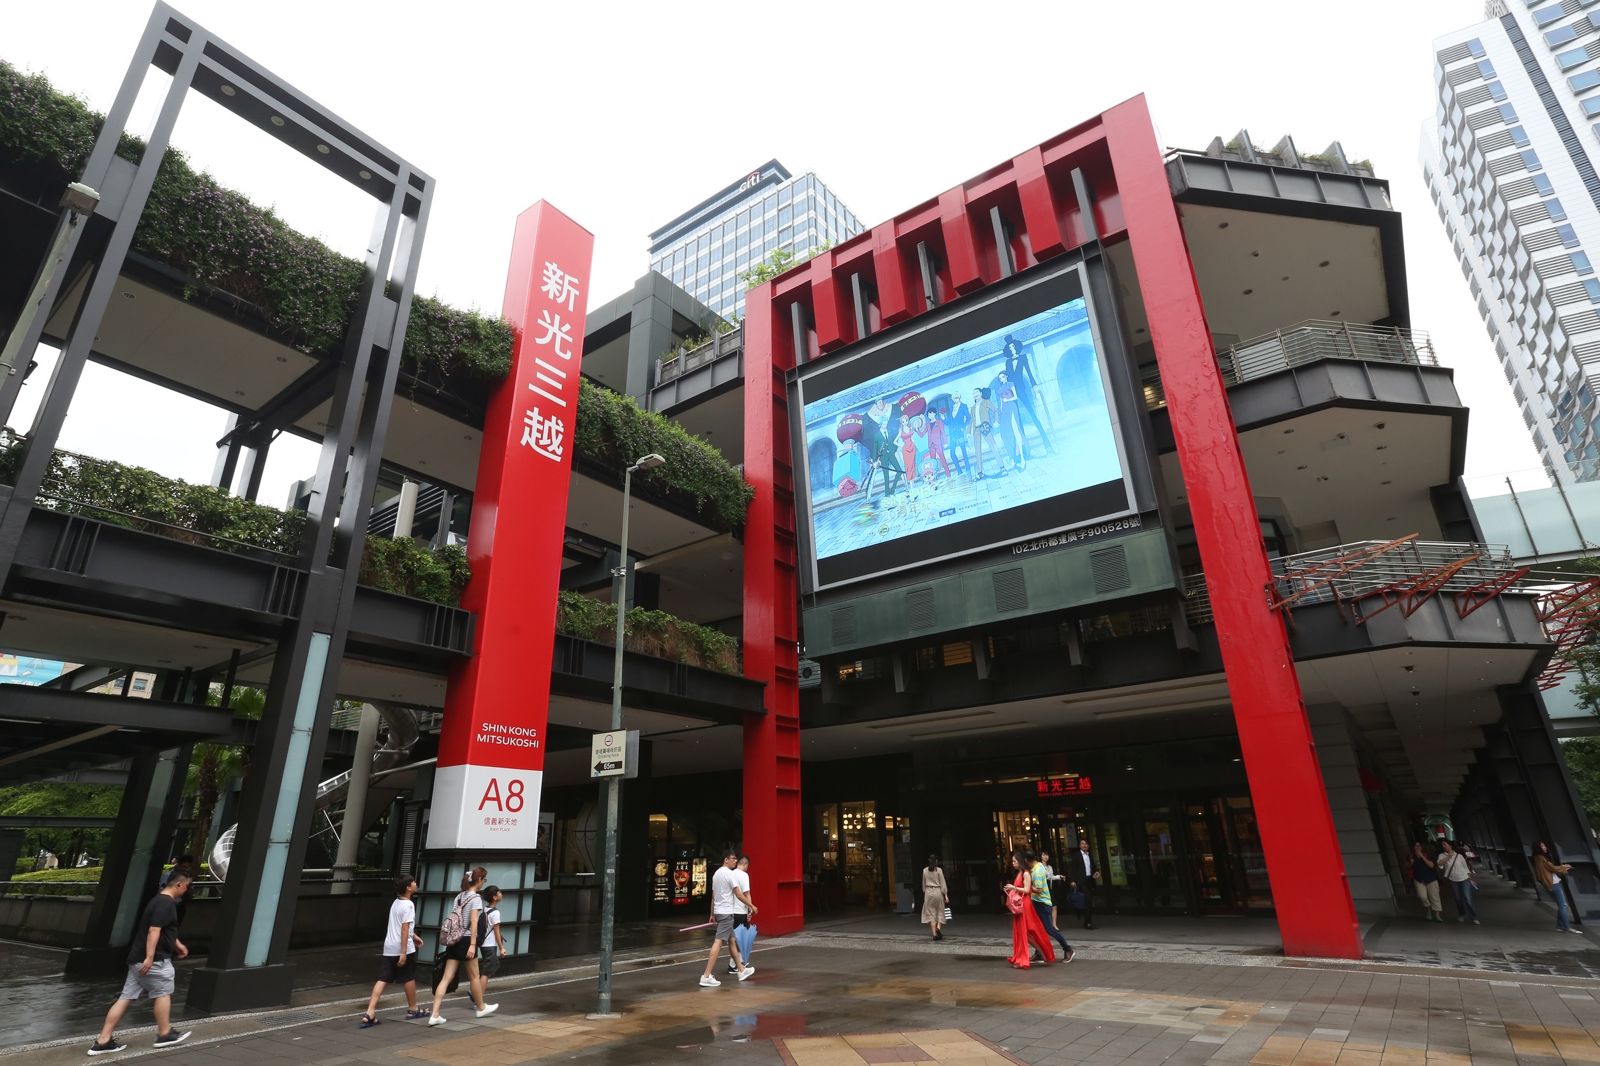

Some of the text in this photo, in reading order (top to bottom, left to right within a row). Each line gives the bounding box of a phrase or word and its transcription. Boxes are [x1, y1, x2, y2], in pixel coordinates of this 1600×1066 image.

[739, 172, 760, 192] citi
[520, 260, 580, 463] 新光三越
[482, 722, 537, 737] SHIN KONG
[476, 733, 539, 749] MITSUKOSHI
[603, 762, 616, 770] 65m
[1037, 777, 1092, 792] 新光三越
[478, 777, 525, 813] A8
